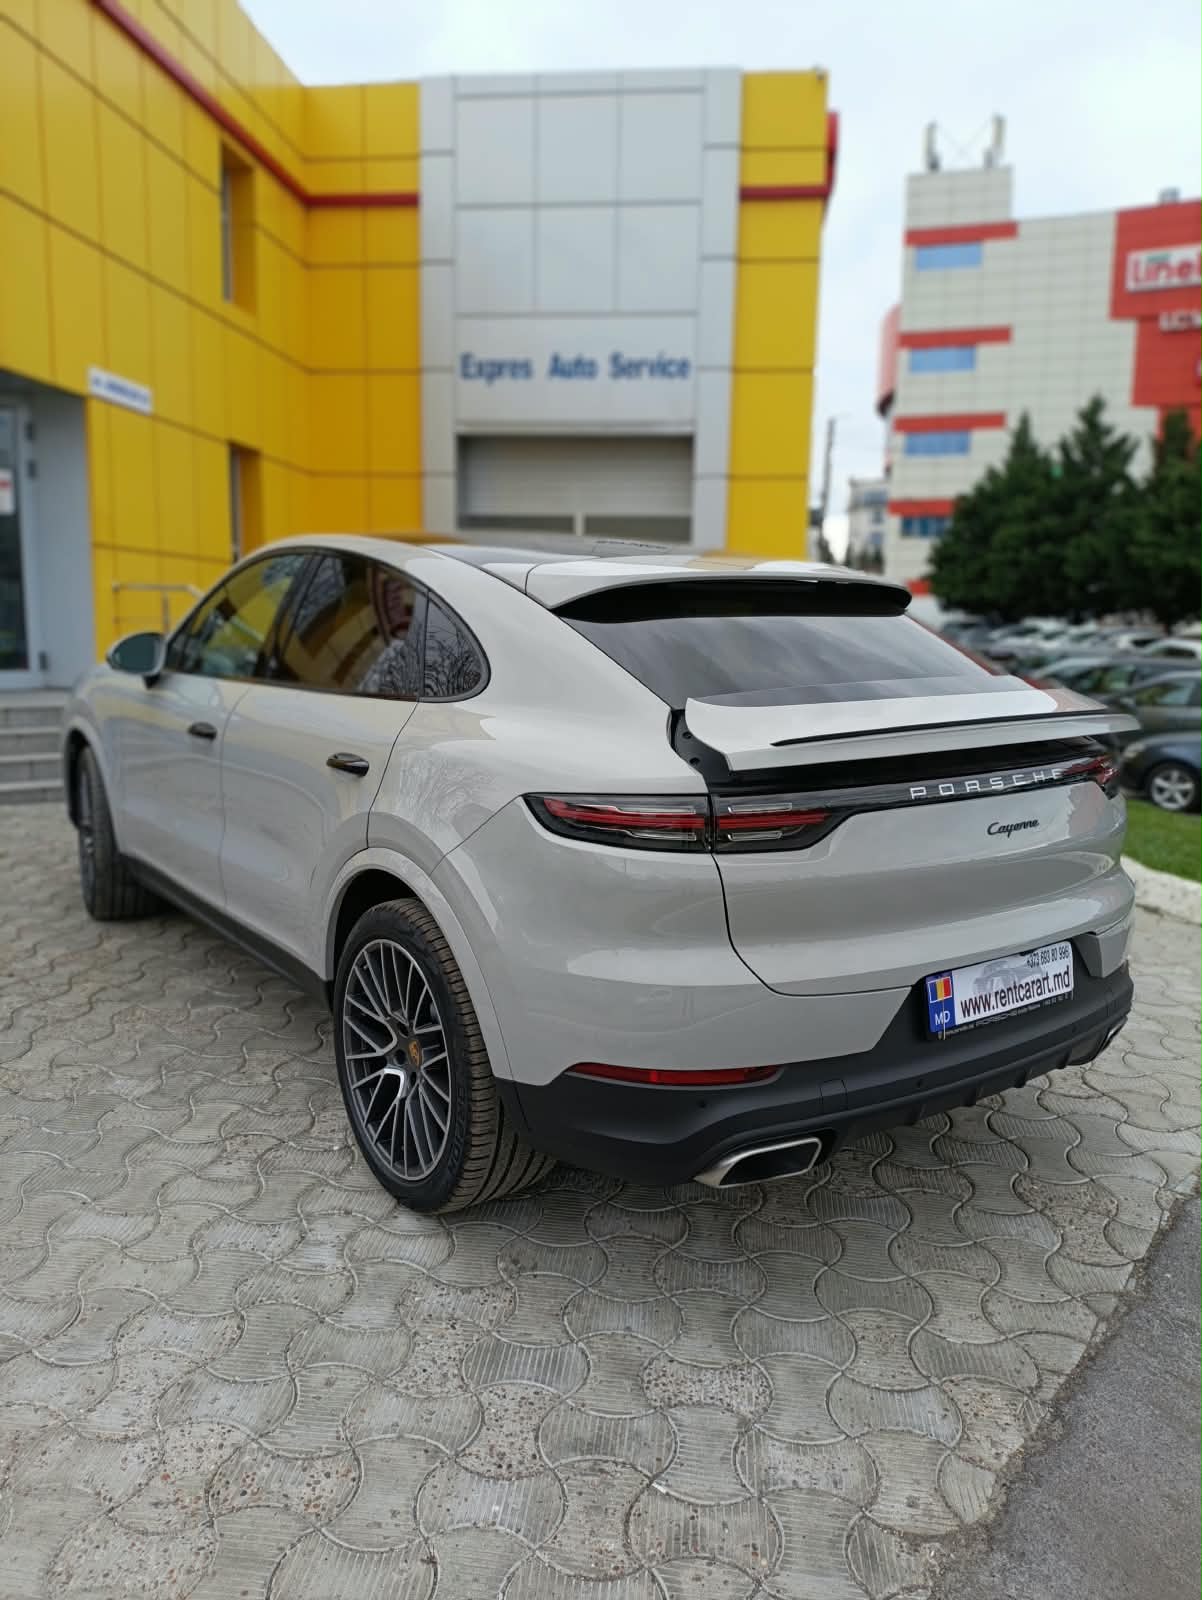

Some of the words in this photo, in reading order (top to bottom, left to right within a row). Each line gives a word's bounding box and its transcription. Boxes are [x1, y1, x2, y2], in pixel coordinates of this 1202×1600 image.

[460, 351, 533, 387] Expres
[548, 351, 598, 380] Auto
[610, 350, 690, 380] Service
[910, 768, 1063, 799] PORSCHE
[987, 819, 1040, 838] Cayenne
[961, 964, 1070, 1019] www.rentcarart.md
[935, 1010, 950, 1025] MD
